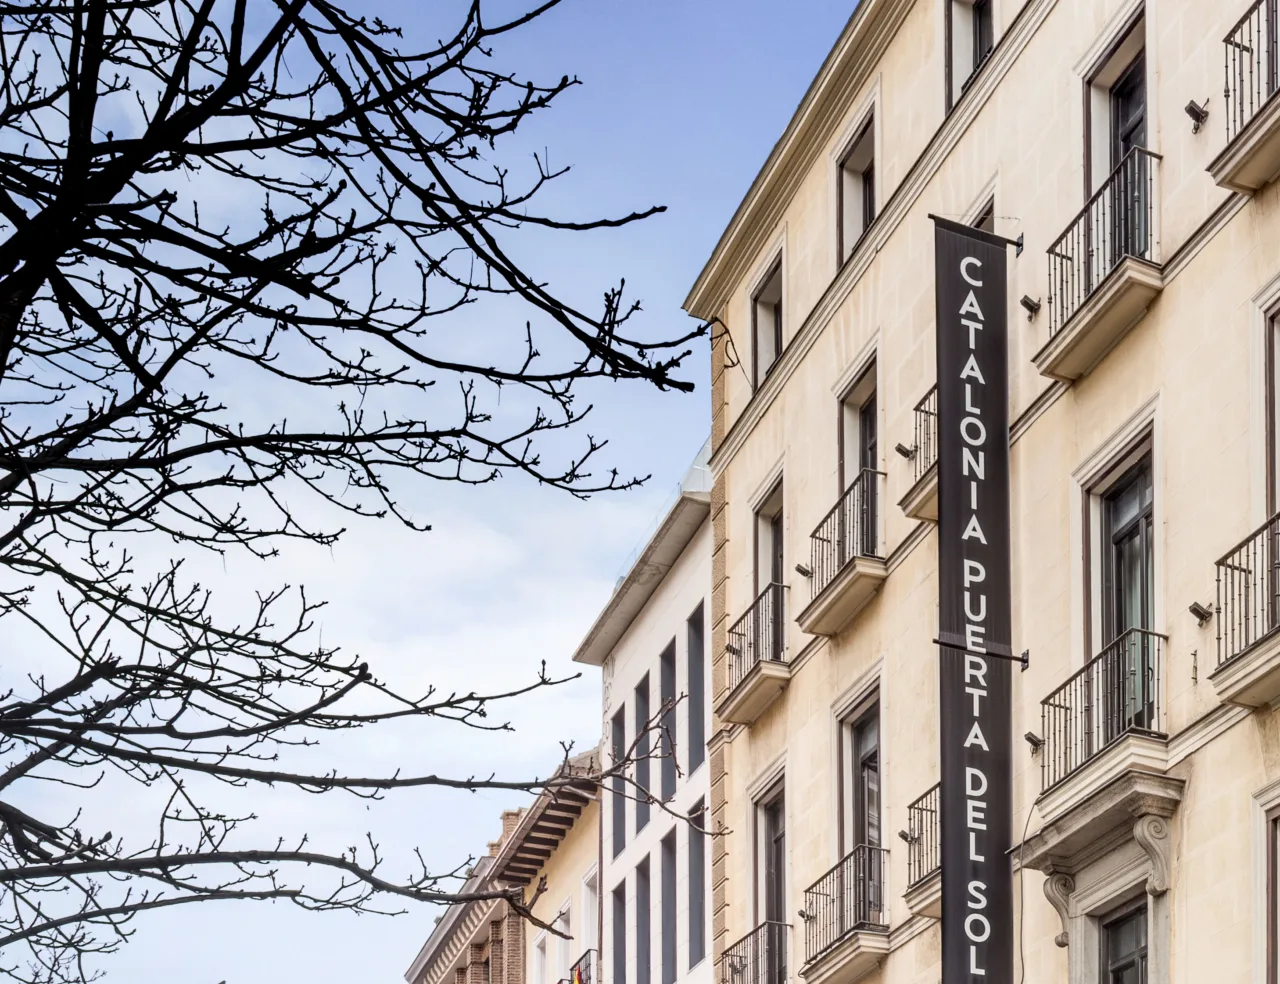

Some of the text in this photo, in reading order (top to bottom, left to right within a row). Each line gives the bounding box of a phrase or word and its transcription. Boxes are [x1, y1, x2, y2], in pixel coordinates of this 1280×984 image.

[959, 256, 991, 976] CATALONIA PUERTA DEL SOL
